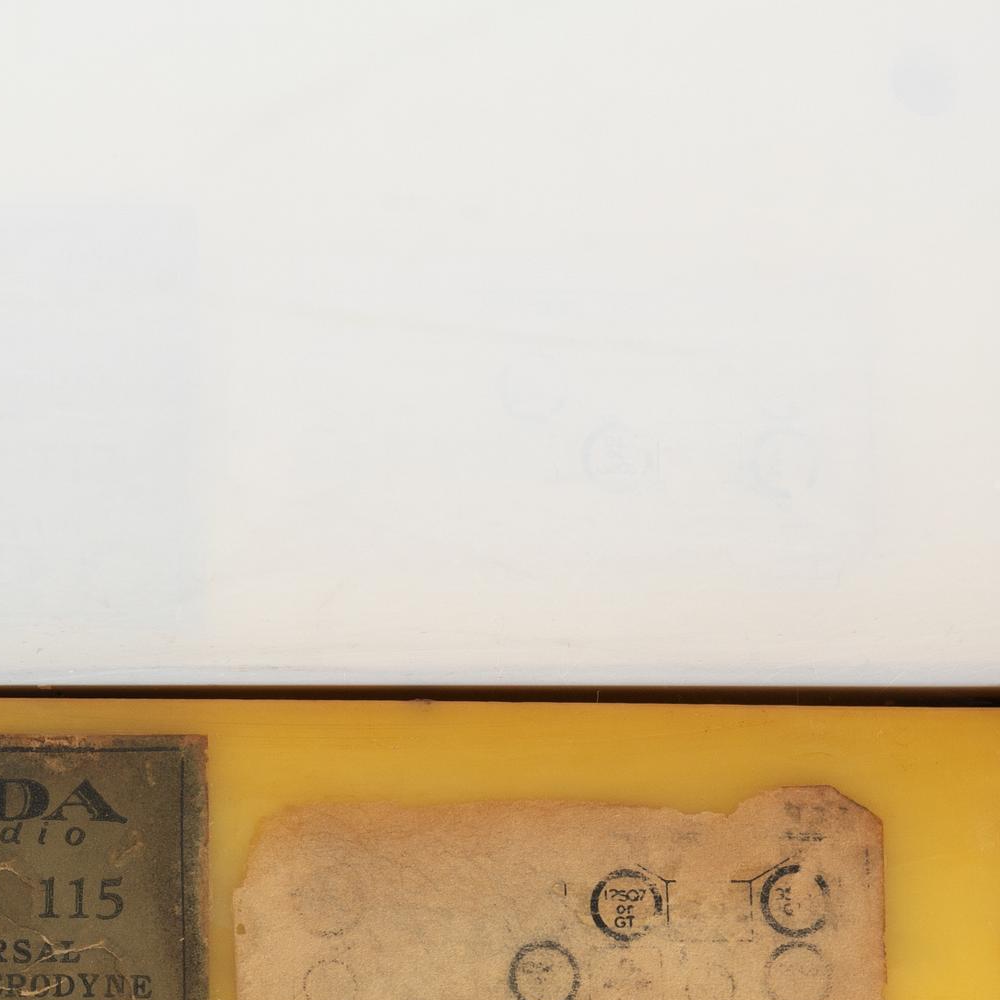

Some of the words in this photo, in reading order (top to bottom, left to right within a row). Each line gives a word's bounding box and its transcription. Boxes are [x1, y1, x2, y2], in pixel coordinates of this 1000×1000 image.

[38, 877, 124, 920] 115
[616, 905, 634, 915] or
[614, 916, 635, 928] GT
